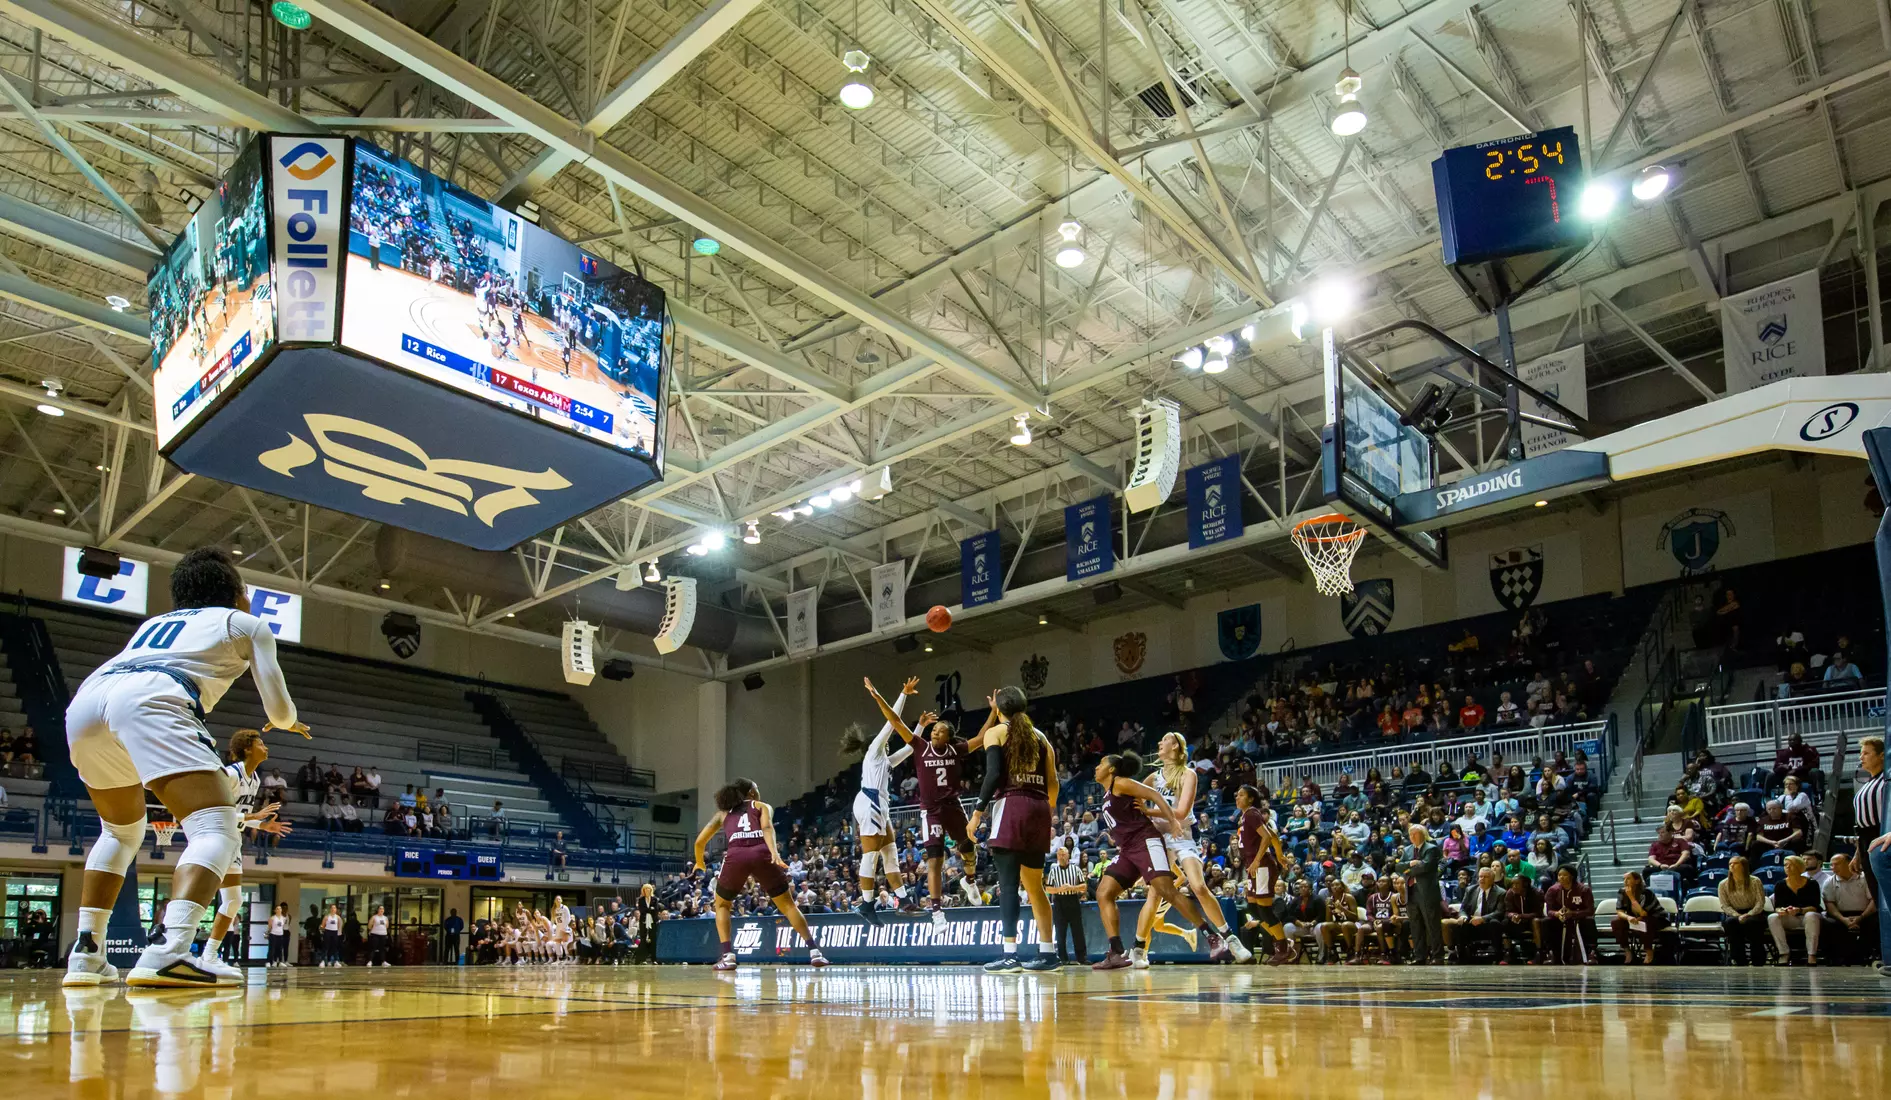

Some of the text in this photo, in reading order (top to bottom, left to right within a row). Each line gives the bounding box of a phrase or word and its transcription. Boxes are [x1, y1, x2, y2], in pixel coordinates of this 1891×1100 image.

[1476, 133, 1538, 149] DAKTRONICS
[1485, 141, 1563, 180] 2:54
[1525, 175, 1560, 223] 7
[286, 189, 328, 337] Follett
[1744, 294, 1797, 313] SCHOLAR
[1747, 287, 1792, 305] RHODES
[406, 338, 447, 362] 12 Rice
[1752, 341, 1797, 365] RICE
[1525, 365, 1568, 381] SCHOLAR
[1527, 360, 1564, 375] RHODES
[1760, 366, 1796, 380] CLYDE
[495, 374, 508, 385] 17
[513, 380, 539, 398] Texas
[539, 390, 563, 409] A&M
[575, 404, 594, 418] 2:54
[603, 414, 609, 424] 7
[1527, 431, 1564, 445] CHARL
[1529, 437, 1567, 452] SHANOR
[1437, 468, 1521, 510] SPALDING
[1202, 504, 1226, 521] RICE
[1202, 518, 1225, 529] ROBERT
[1202, 525, 1226, 537] WILSON
[1078, 540, 1098, 556] RICE
[1076, 557, 1100, 569] RICHARD
[1077, 564, 1100, 575] SMALLEY
[971, 571, 990, 585] RICE
[250, 589, 291, 634] E
[132, 620, 187, 649] 10
[936, 767, 948, 787] 2
[1016, 773, 1045, 785] CARTER
[737, 813, 751, 831] 4
[729, 830, 764, 842] SHINGTO
[404, 851, 419, 859] RICE
[105, 938, 133, 946] mart
[733, 930, 763, 947] OWL
[776, 926, 793, 948] THE
[795, 926, 819, 947] TE
[819, 923, 910, 948] STUDENT-ATHLETE
[980, 919, 1024, 945] BEGS
